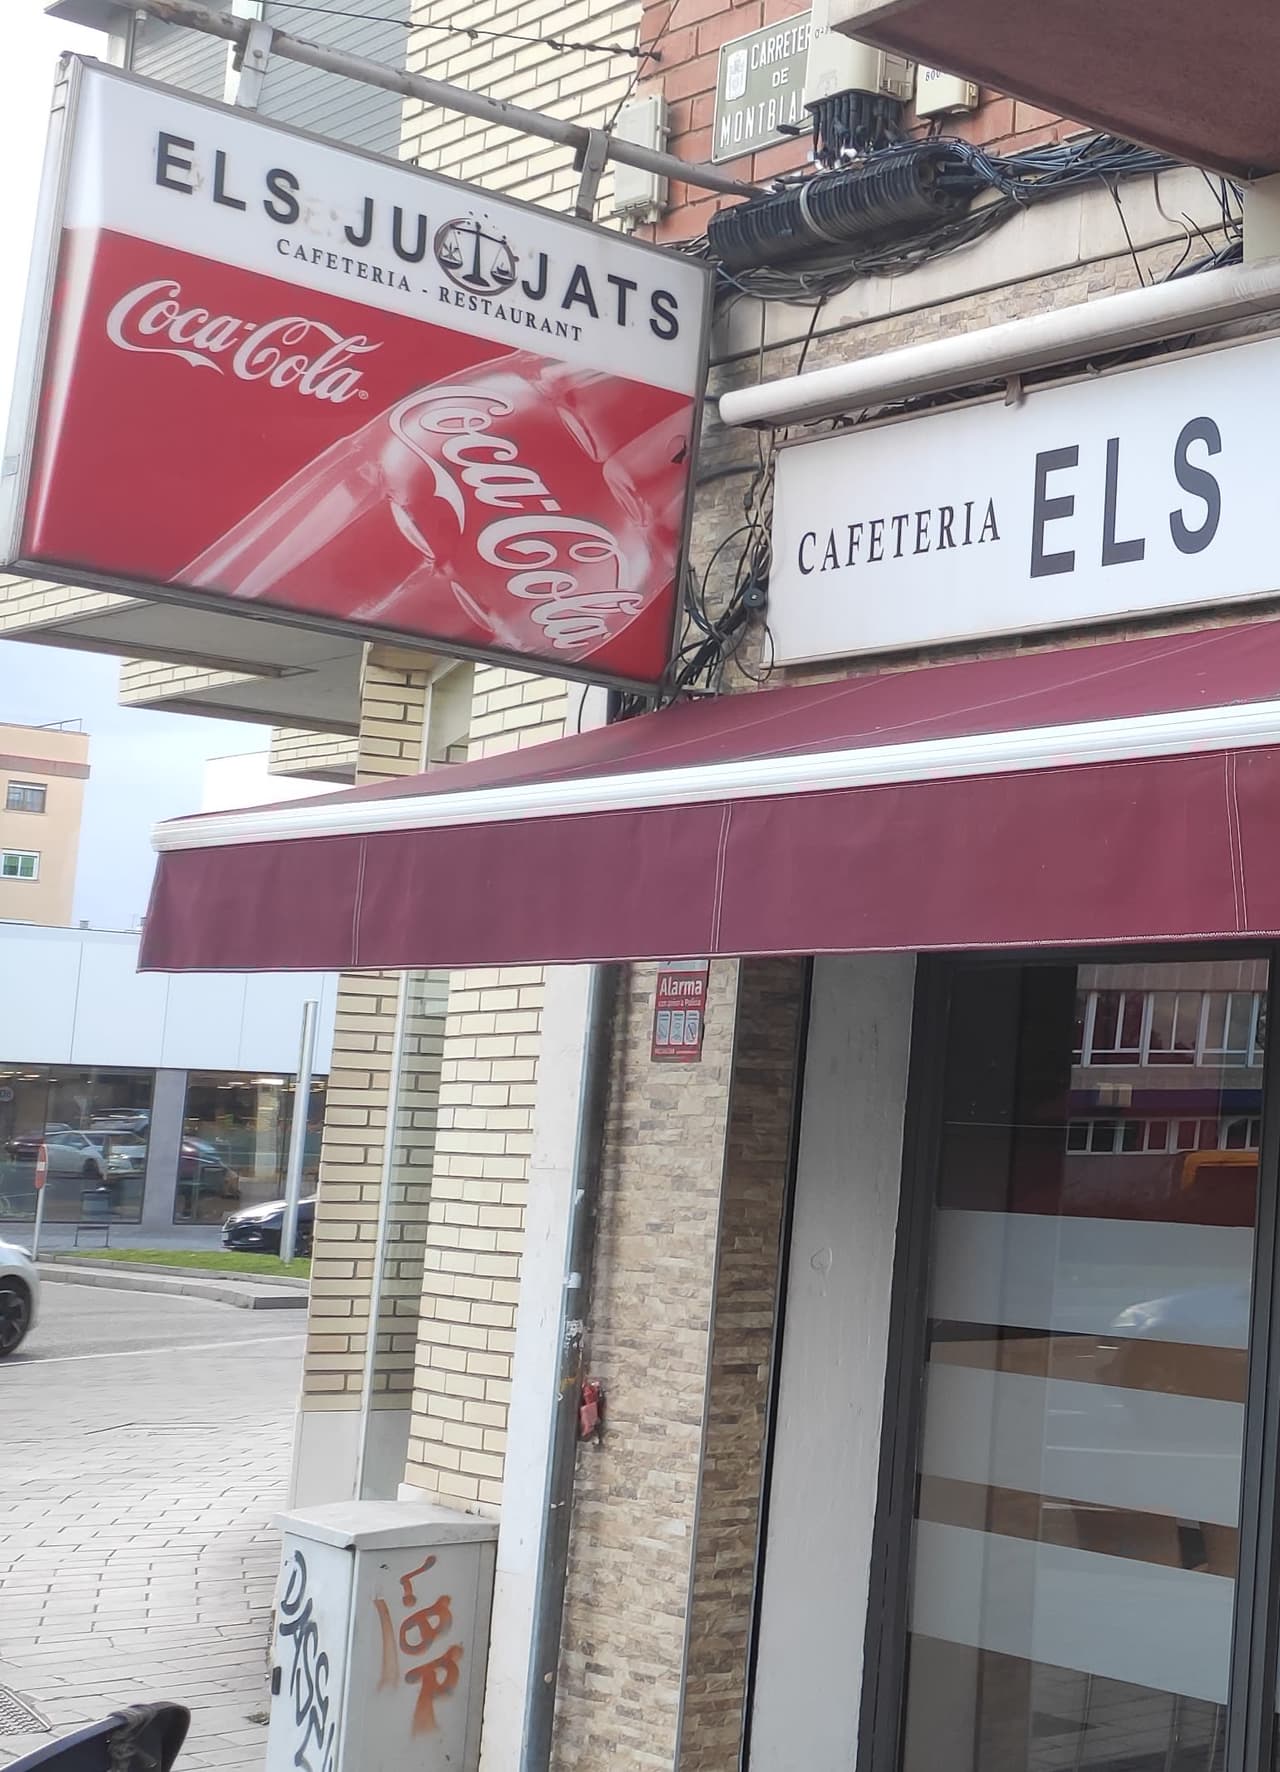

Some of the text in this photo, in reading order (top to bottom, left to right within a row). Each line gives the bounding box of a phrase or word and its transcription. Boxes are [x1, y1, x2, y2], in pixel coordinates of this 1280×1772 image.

[772, 67, 789, 88] DE
[155, 131, 300, 225] ELS
[106, 279, 384, 404] Coca-Cola
[276, 238, 411, 292] CAFETERIA
[438, 285, 583, 342] RESTAURANT
[388, 385, 644, 650] Coca-Cola
[798, 496, 1002, 577] CAFETERIA
[1029, 415, 1222, 580] ELS
[660, 976, 702, 996] Alarma
